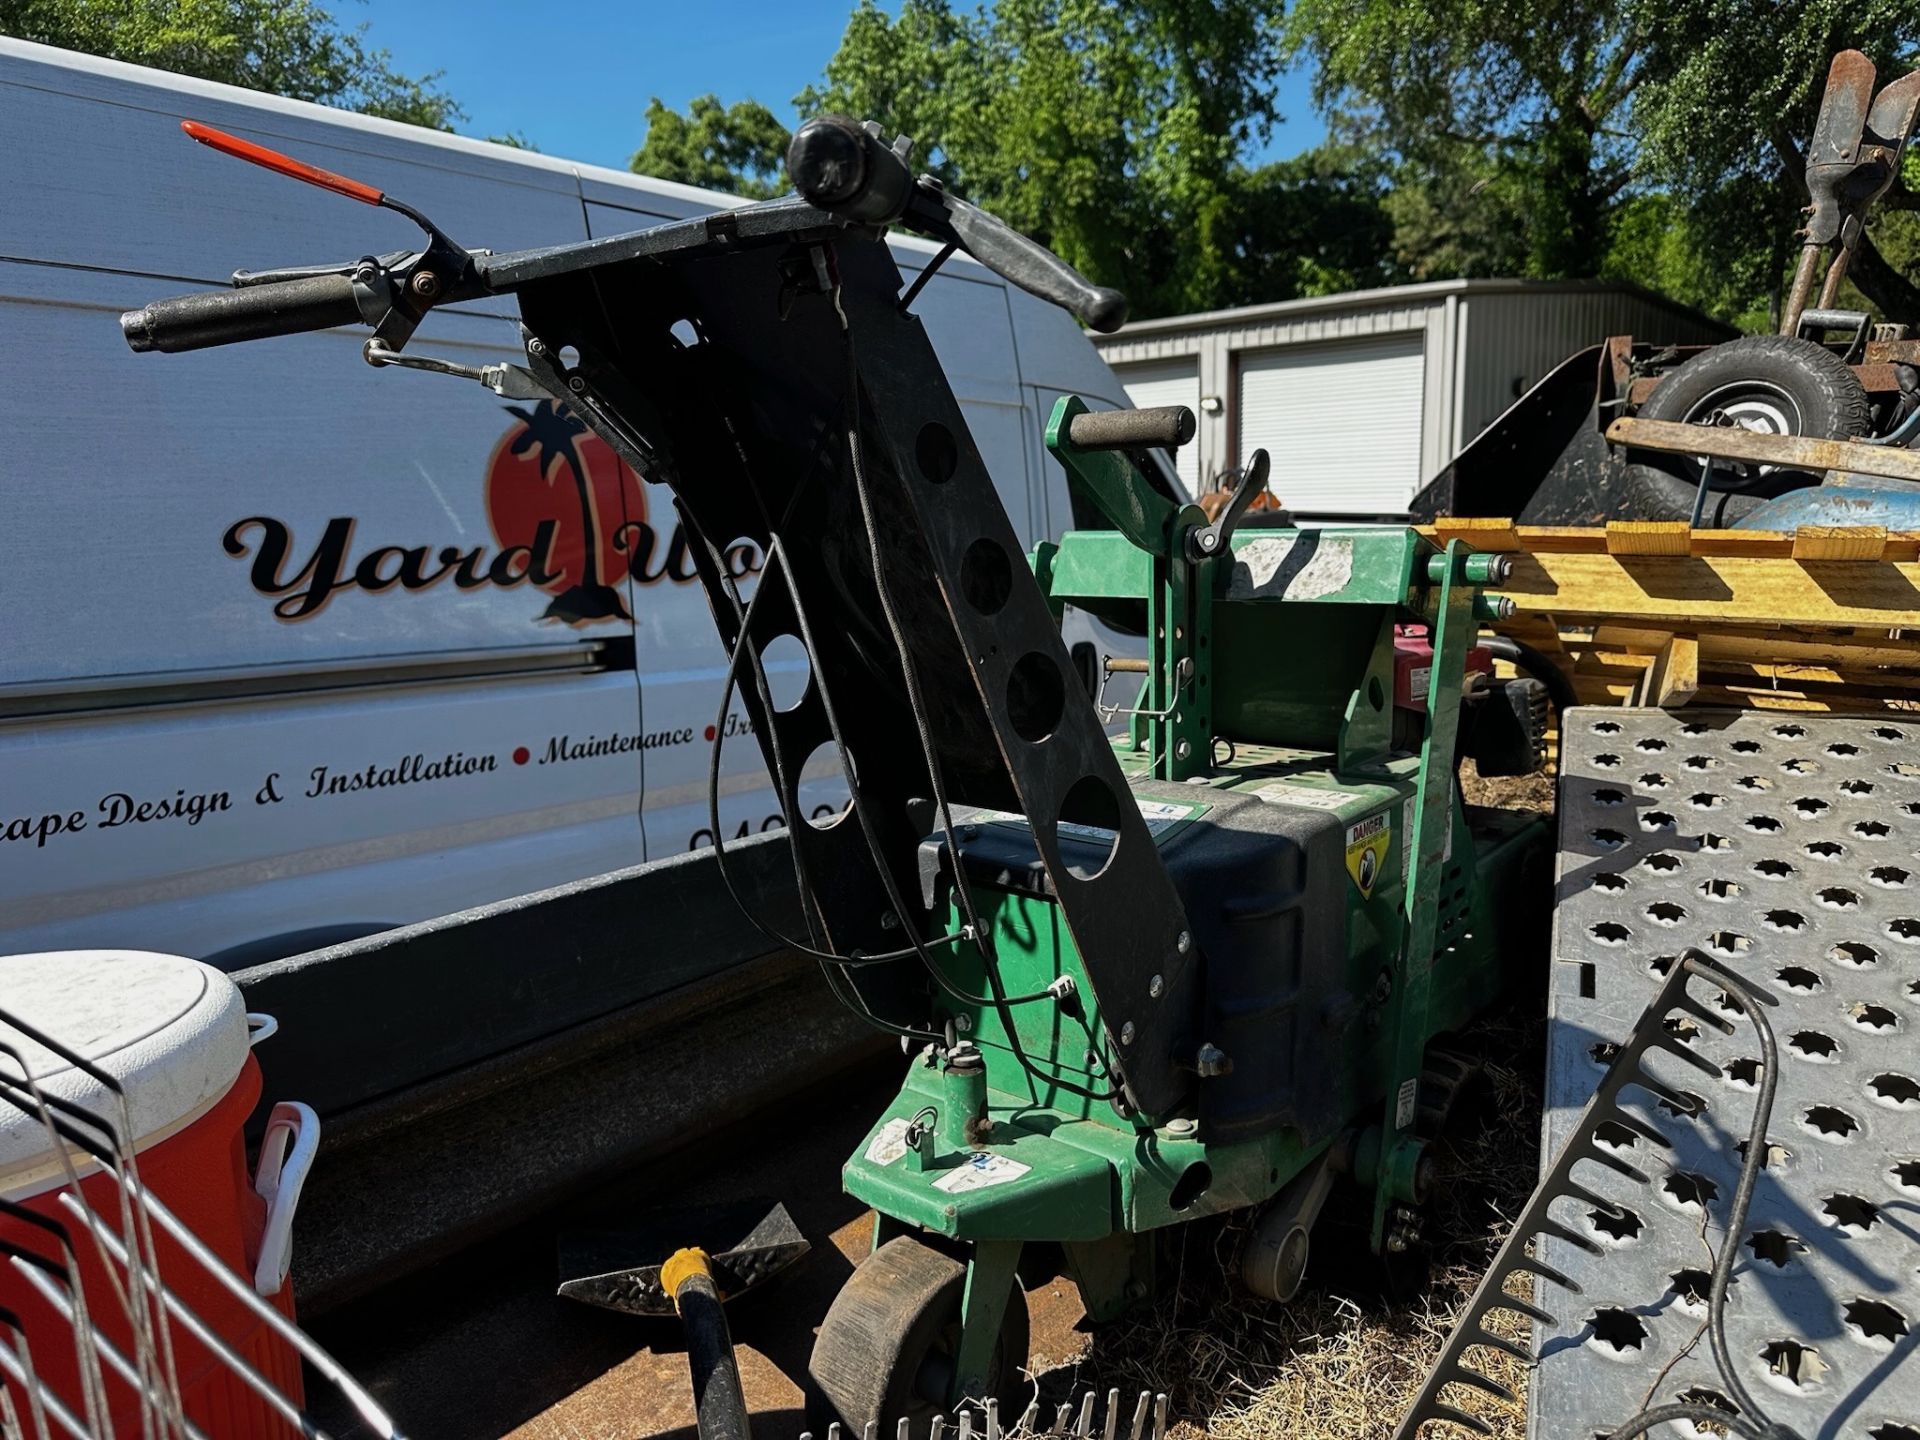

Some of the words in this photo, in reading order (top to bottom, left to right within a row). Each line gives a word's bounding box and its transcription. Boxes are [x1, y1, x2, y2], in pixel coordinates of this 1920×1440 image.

[222, 516, 567, 623] Yard
[97, 790, 233, 828] Design
[255, 772, 284, 805] &
[305, 753, 498, 798] Installation
[538, 727, 695, 765] Maintenance
[1353, 815, 1384, 842] DANGER
